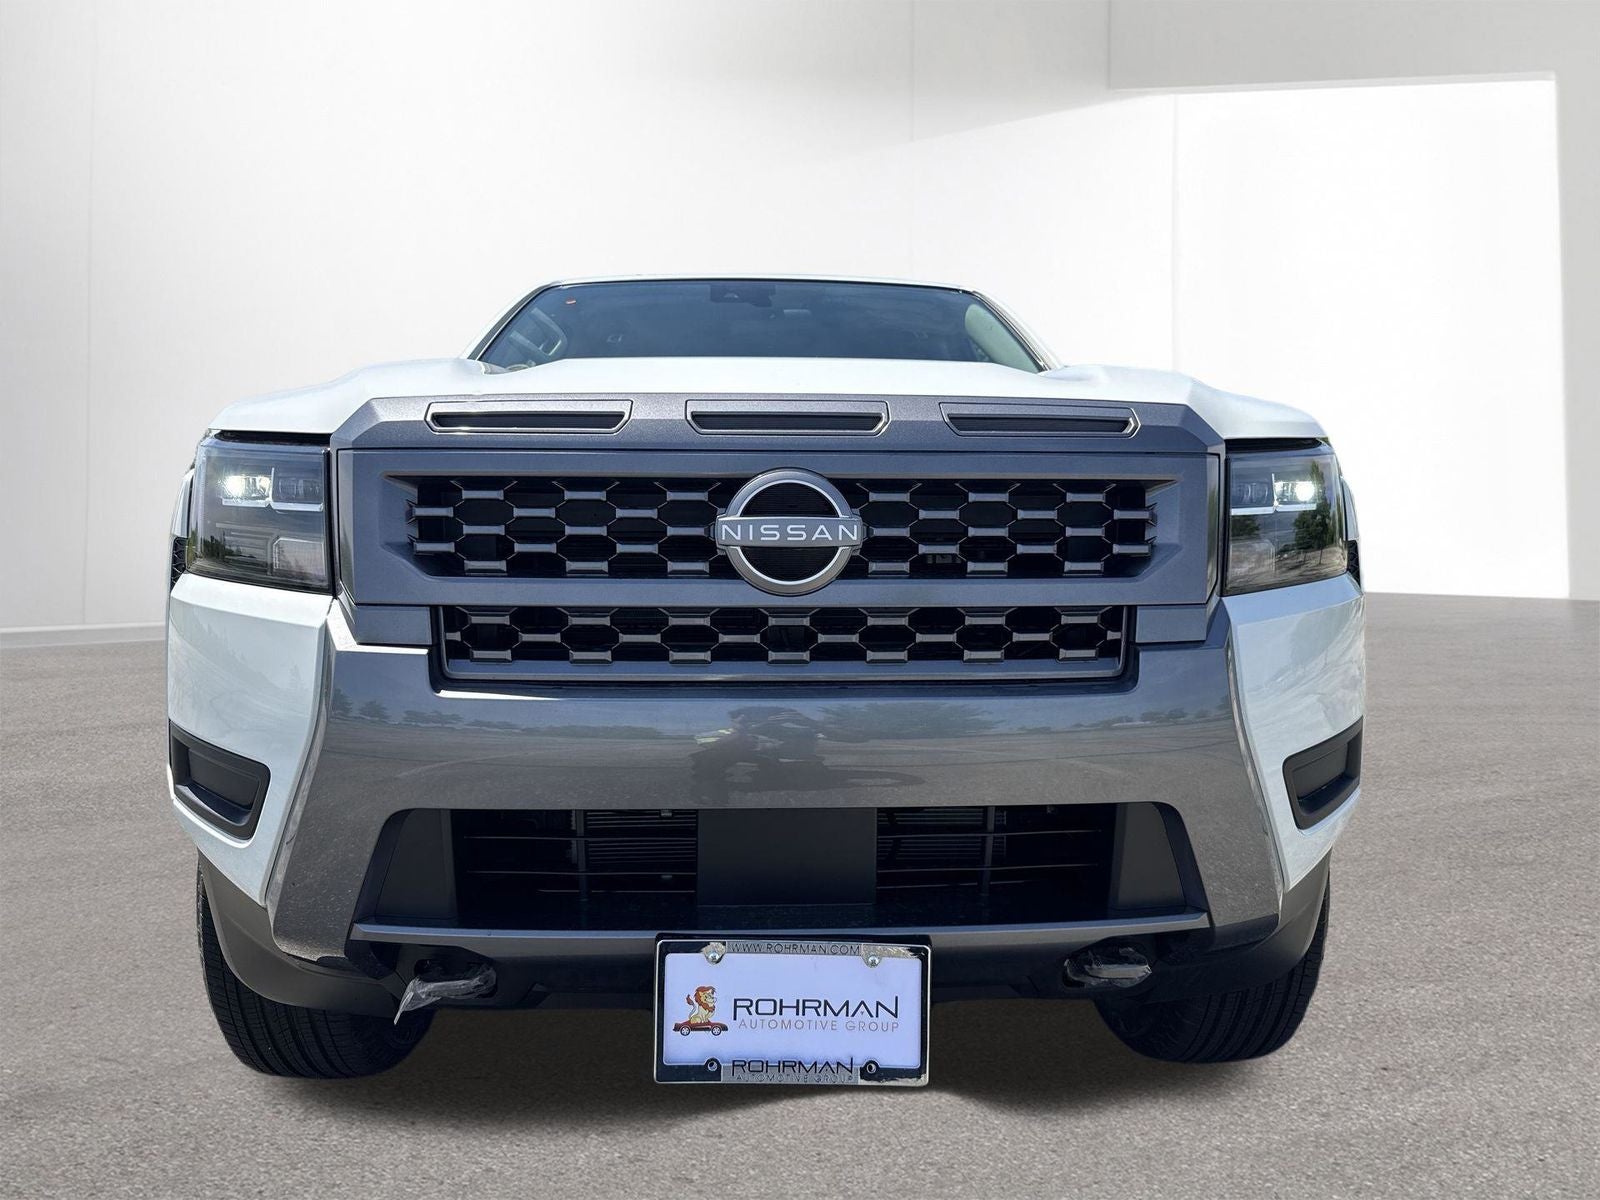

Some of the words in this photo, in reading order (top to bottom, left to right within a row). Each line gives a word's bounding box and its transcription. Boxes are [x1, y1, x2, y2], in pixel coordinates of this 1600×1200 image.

[721, 524, 858, 541] NISSAN
[731, 943, 860, 955] WWW.ROHRMAN.COM
[733, 996, 898, 1020] ROHRMAN
[738, 1018, 838, 1031] AUTOMOTIVE
[845, 1020, 899, 1032] GROUP
[732, 1057, 854, 1077] ROHRMAN
